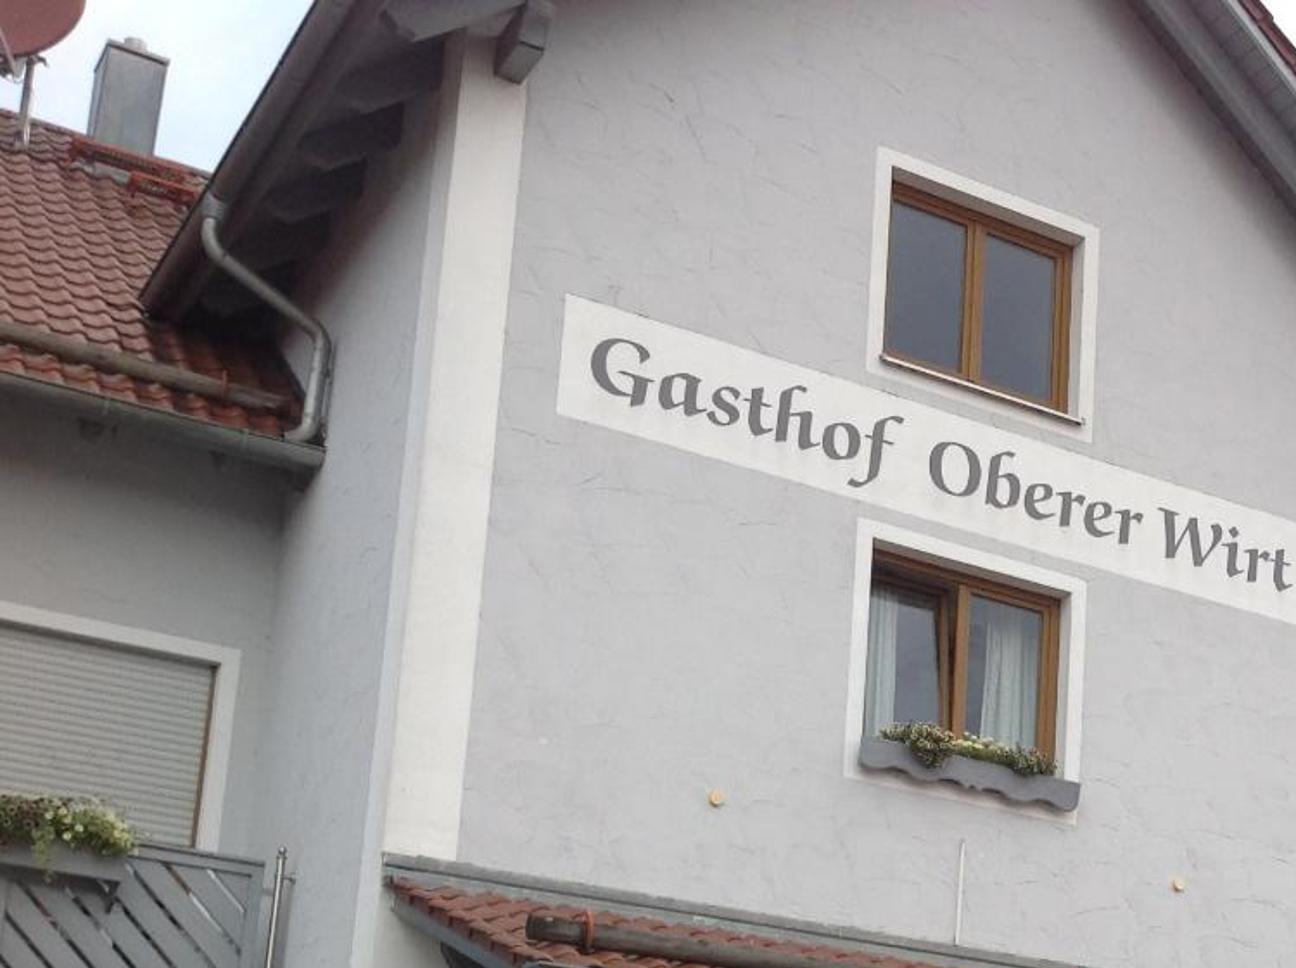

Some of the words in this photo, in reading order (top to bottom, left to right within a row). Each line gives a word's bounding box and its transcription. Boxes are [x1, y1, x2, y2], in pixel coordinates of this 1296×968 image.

[590, 337, 904, 488] Gasthof
[928, 441, 1144, 545] Oberer
[1157, 506, 1293, 592] Wirt
